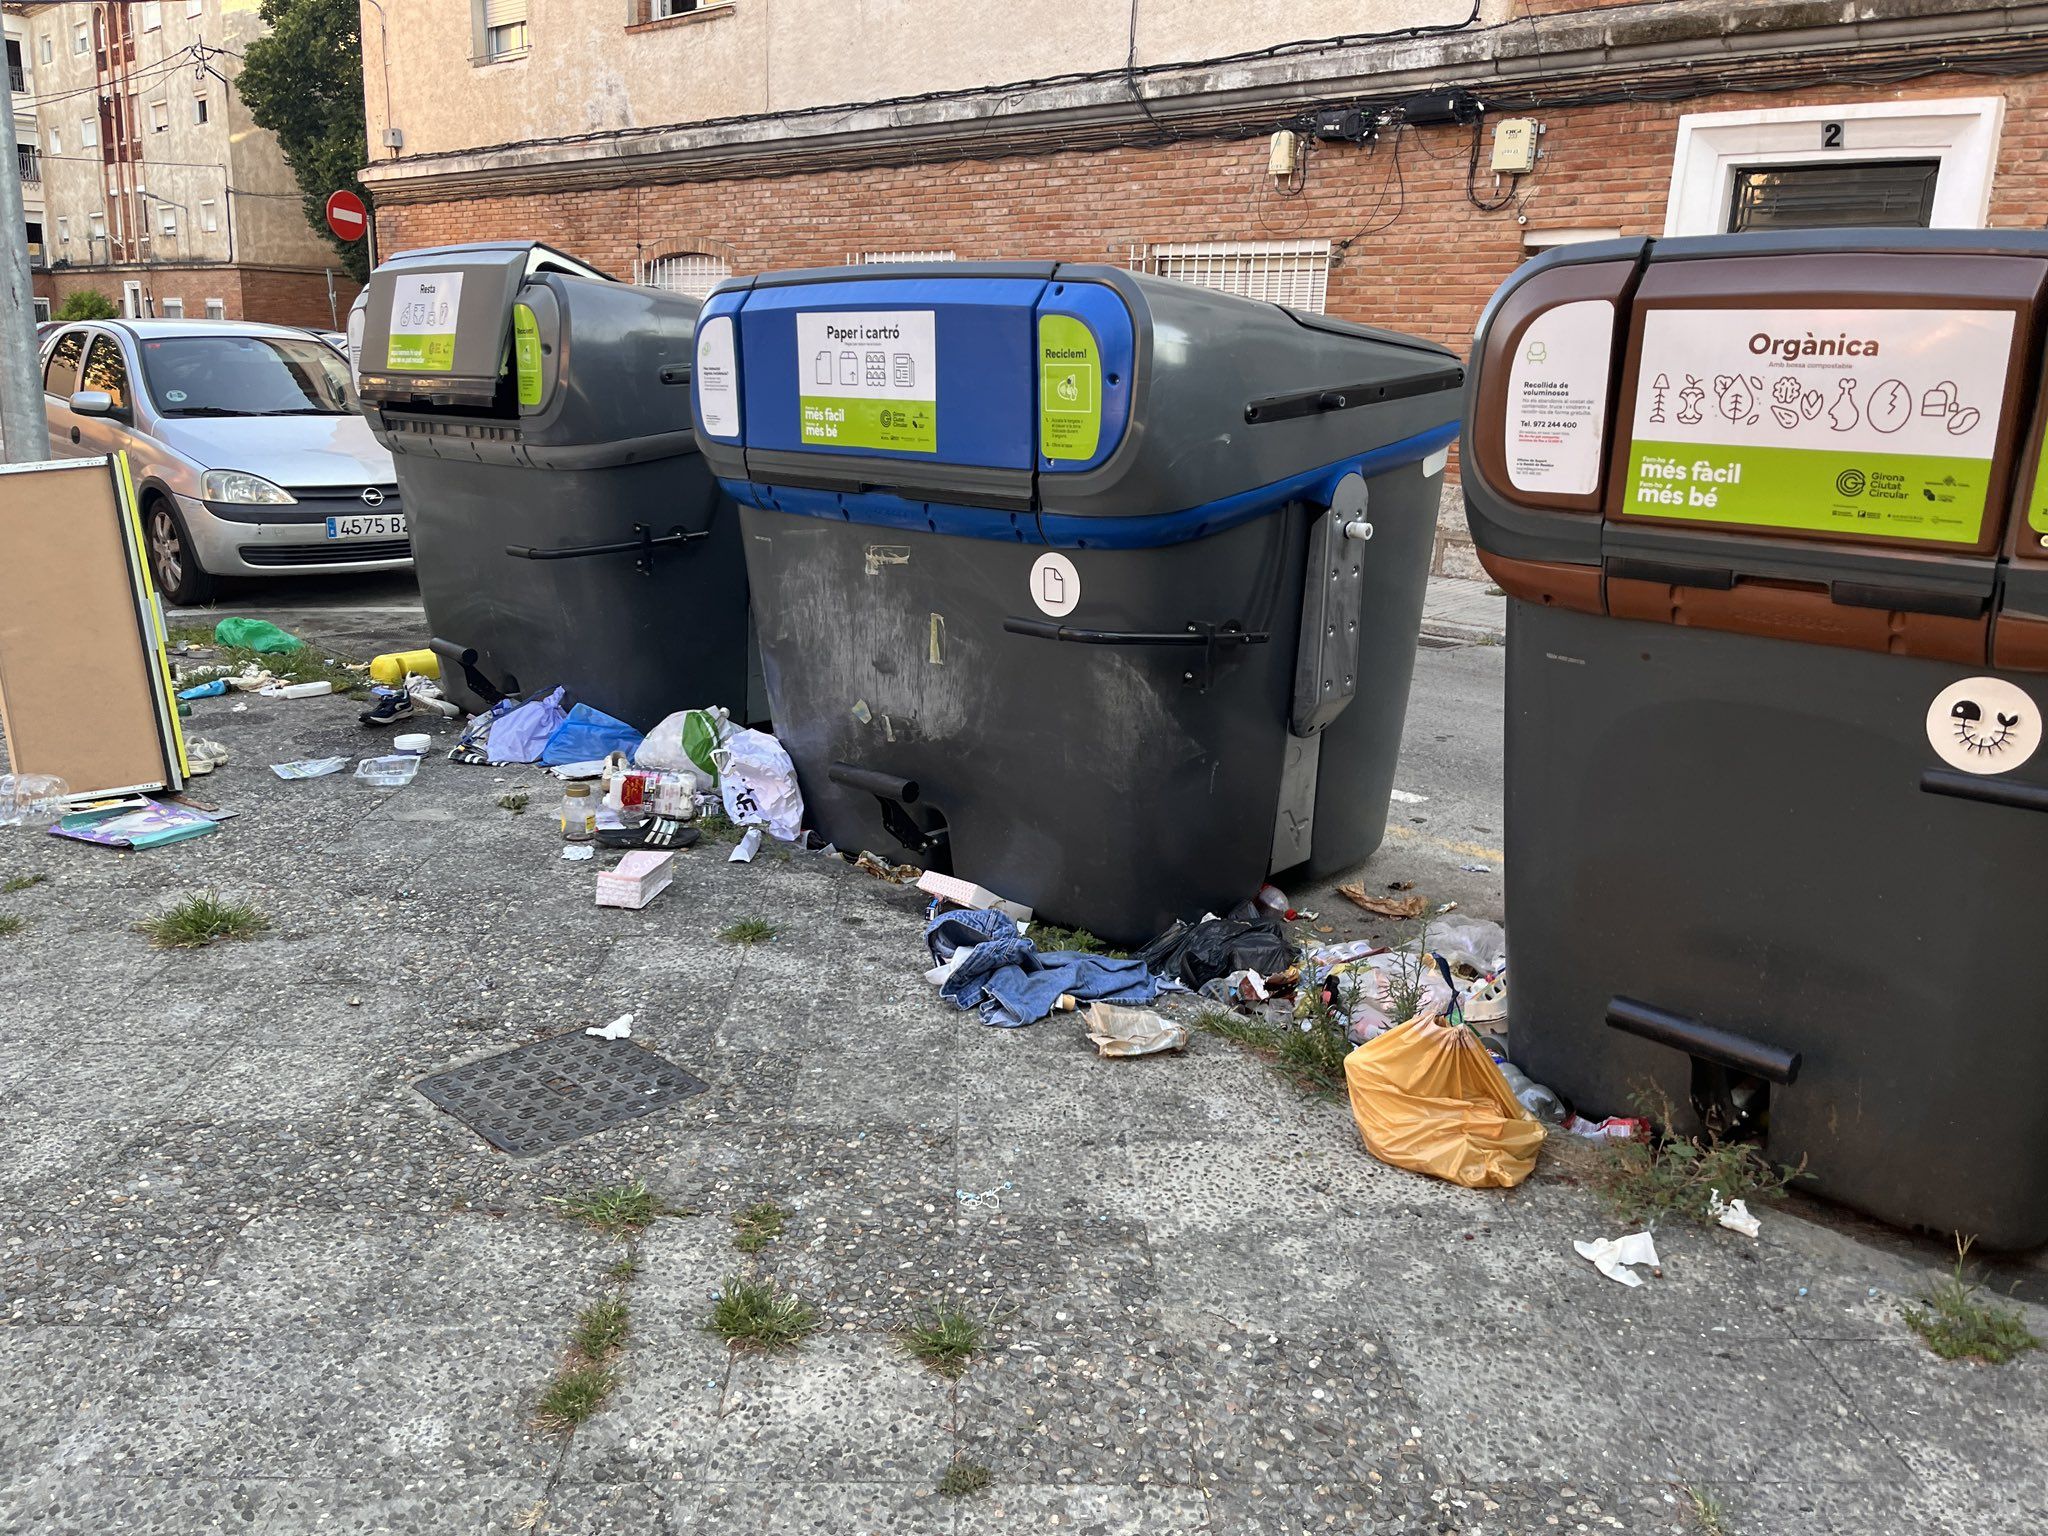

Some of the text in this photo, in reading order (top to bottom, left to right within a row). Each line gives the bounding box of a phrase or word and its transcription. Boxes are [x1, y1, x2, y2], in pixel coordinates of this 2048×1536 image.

[1824, 123, 1841, 148] 2
[420, 283, 436, 294] Resta
[827, 324, 900, 342] Paper i cartró
[1045, 348, 1087, 359] Reciclem!
[1748, 332, 1880, 361] Orgànica
[1523, 389, 1569, 397] voluminosos
[805, 408, 823, 421] més
[806, 423, 838, 438] més bé
[1640, 458, 1742, 484] més fàcil
[1871, 472, 1905, 481] Girona
[1870, 481, 1902, 490] Ciutat
[1637, 483, 1718, 508] més bé
[1869, 489, 1909, 499] Circular
[341, 518, 385, 535] 4575
